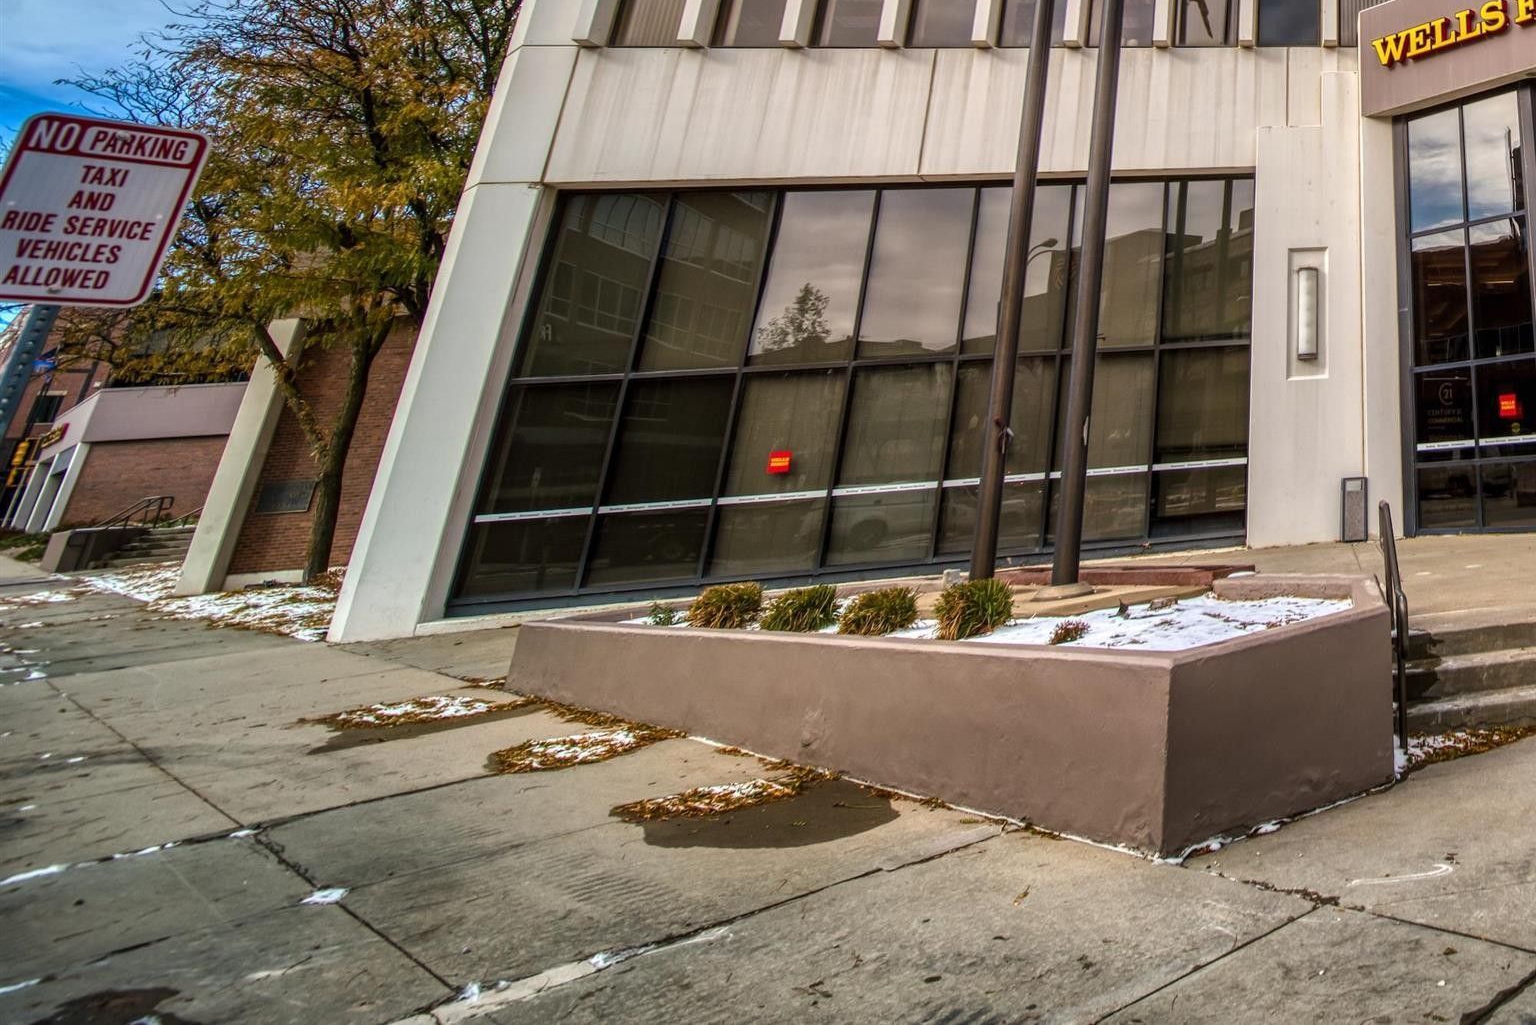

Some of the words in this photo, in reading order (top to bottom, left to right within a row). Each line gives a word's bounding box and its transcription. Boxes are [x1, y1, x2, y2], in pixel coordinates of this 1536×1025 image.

[28, 119, 81, 151] NO
[89, 130, 189, 161] PARKING
[80, 165, 130, 188] TAXI
[67, 190, 116, 212] AND
[0, 210, 58, 233] RIDE
[63, 216, 155, 241] SERVICE
[16, 238, 122, 264] VEHICLES
[2, 264, 110, 289] ALLOWED
